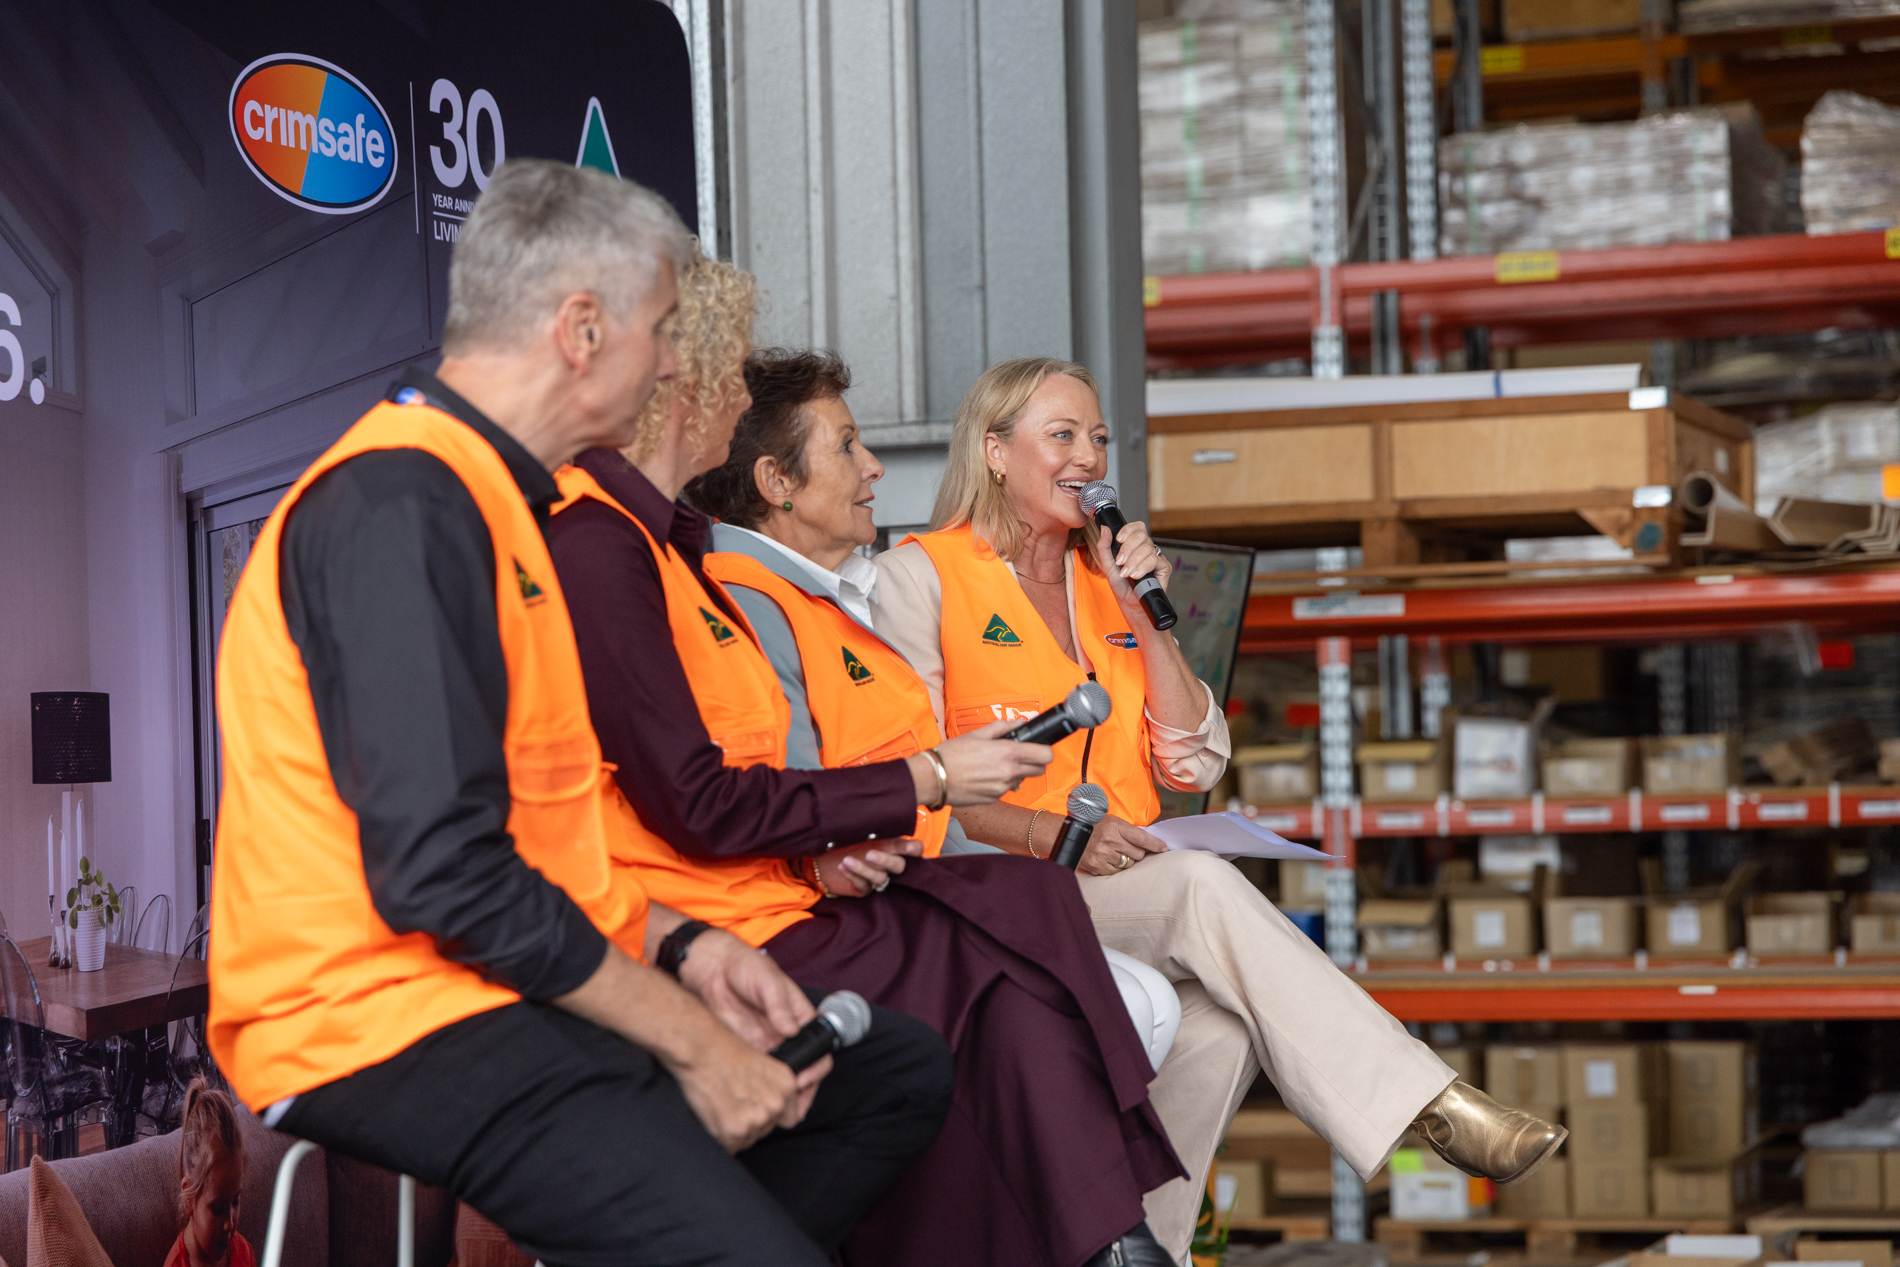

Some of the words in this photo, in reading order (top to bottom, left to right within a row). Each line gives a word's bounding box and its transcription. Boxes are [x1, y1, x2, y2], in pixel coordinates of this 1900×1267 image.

[243, 100, 386, 169] crimsafe
[429, 78, 506, 193] 30
[432, 193, 454, 210] YEAR
